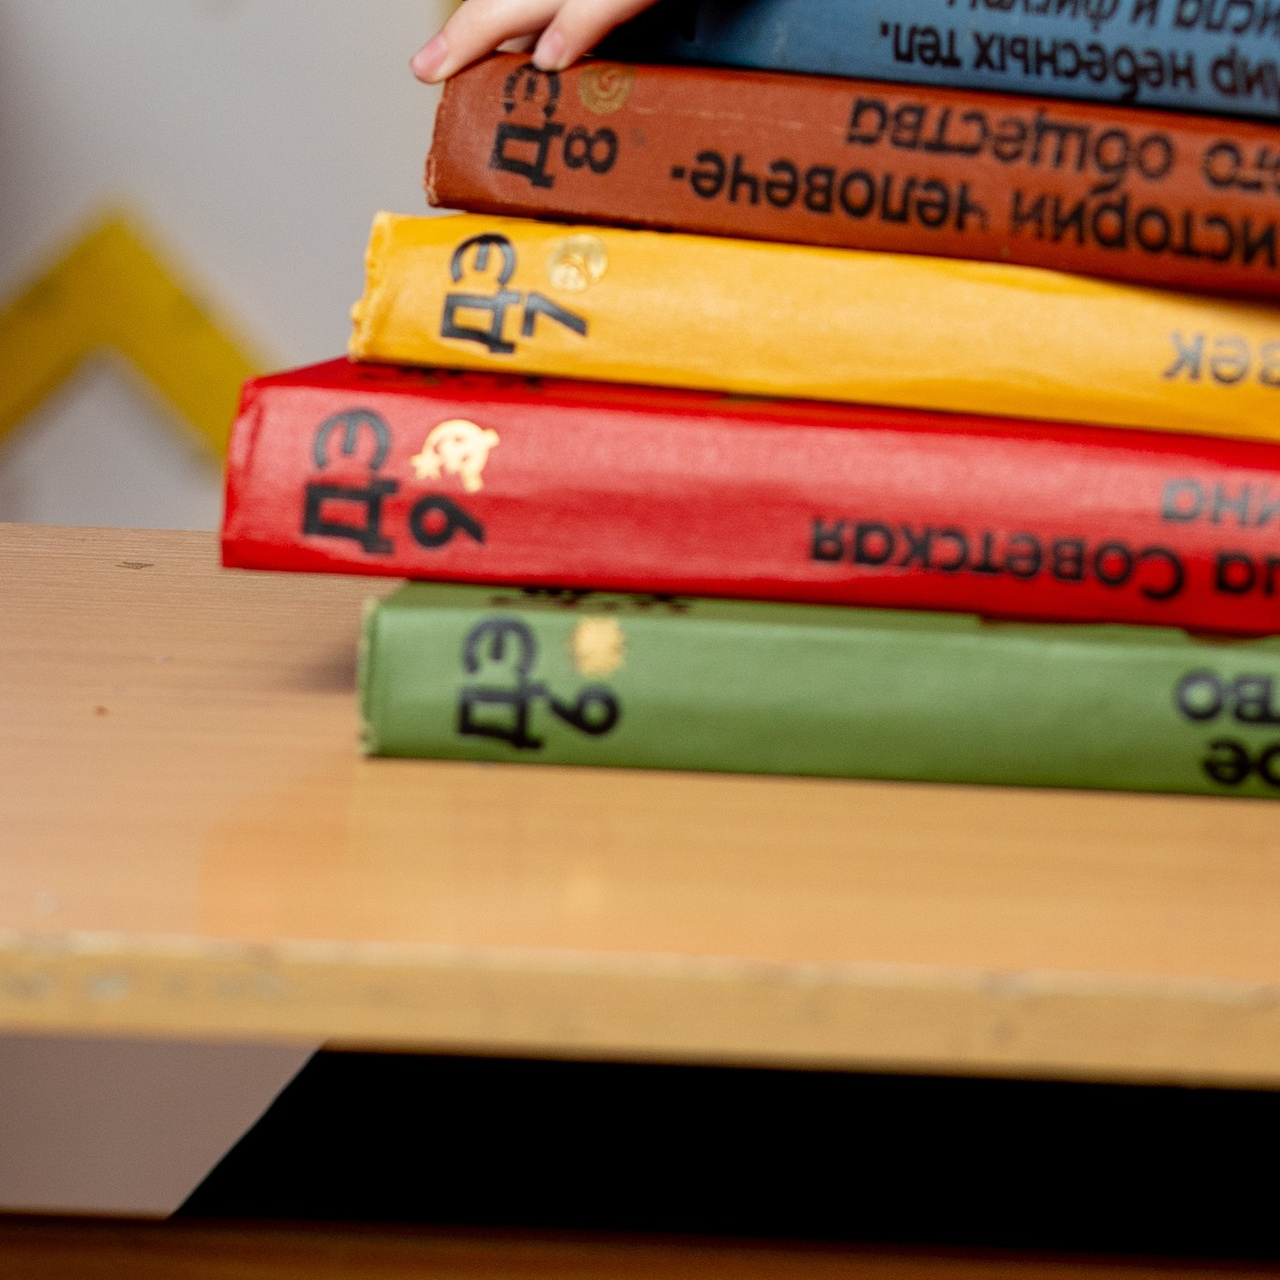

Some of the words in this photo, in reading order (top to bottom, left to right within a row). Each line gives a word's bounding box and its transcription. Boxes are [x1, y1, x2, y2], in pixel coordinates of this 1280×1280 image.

[878, 21, 960, 67] тел.
[971, 31, 1195, 103] небесных
[563, 127, 617, 173] 8
[843, 96, 1173, 195] общества
[668, 149, 985, 233] человече-
[1009, 189, 1278, 267] истории
[439, 232, 520, 354] ДЭ
[520, 291, 587, 337] 7
[302, 407, 397, 555] ДЭ
[808, 516, 1184, 603] Советская
[455, 616, 547, 751] ДЭ
